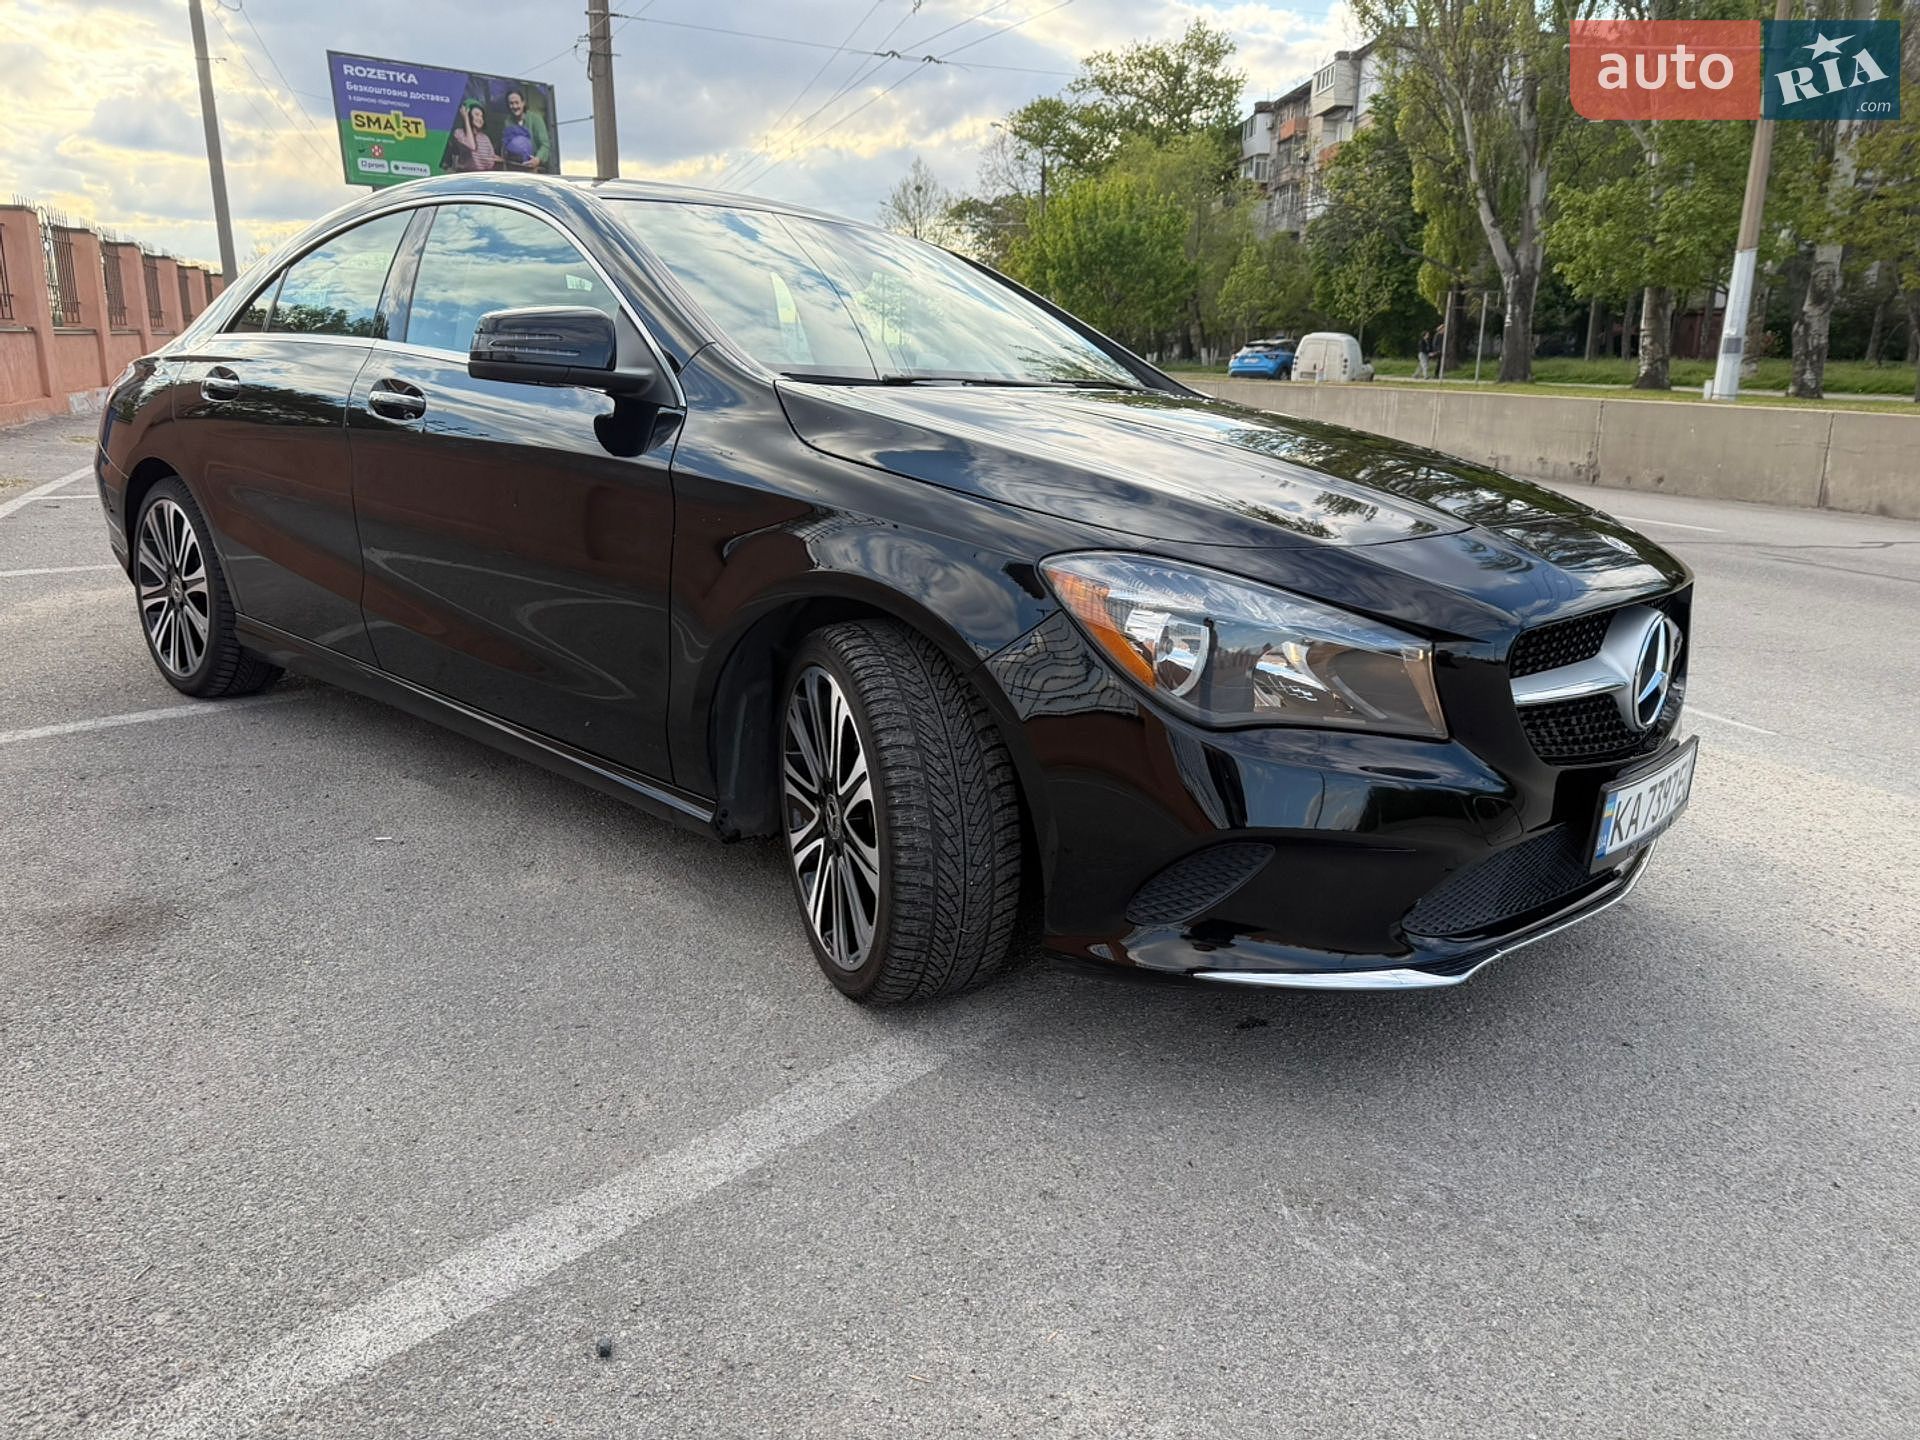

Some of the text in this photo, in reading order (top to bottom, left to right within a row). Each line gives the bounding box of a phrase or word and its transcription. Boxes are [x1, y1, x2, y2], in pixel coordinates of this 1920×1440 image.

[343, 64, 418, 85] ROZETKA
[346, 81, 408, 98] Безкоштовна
[410, 91, 450, 103] доставка
